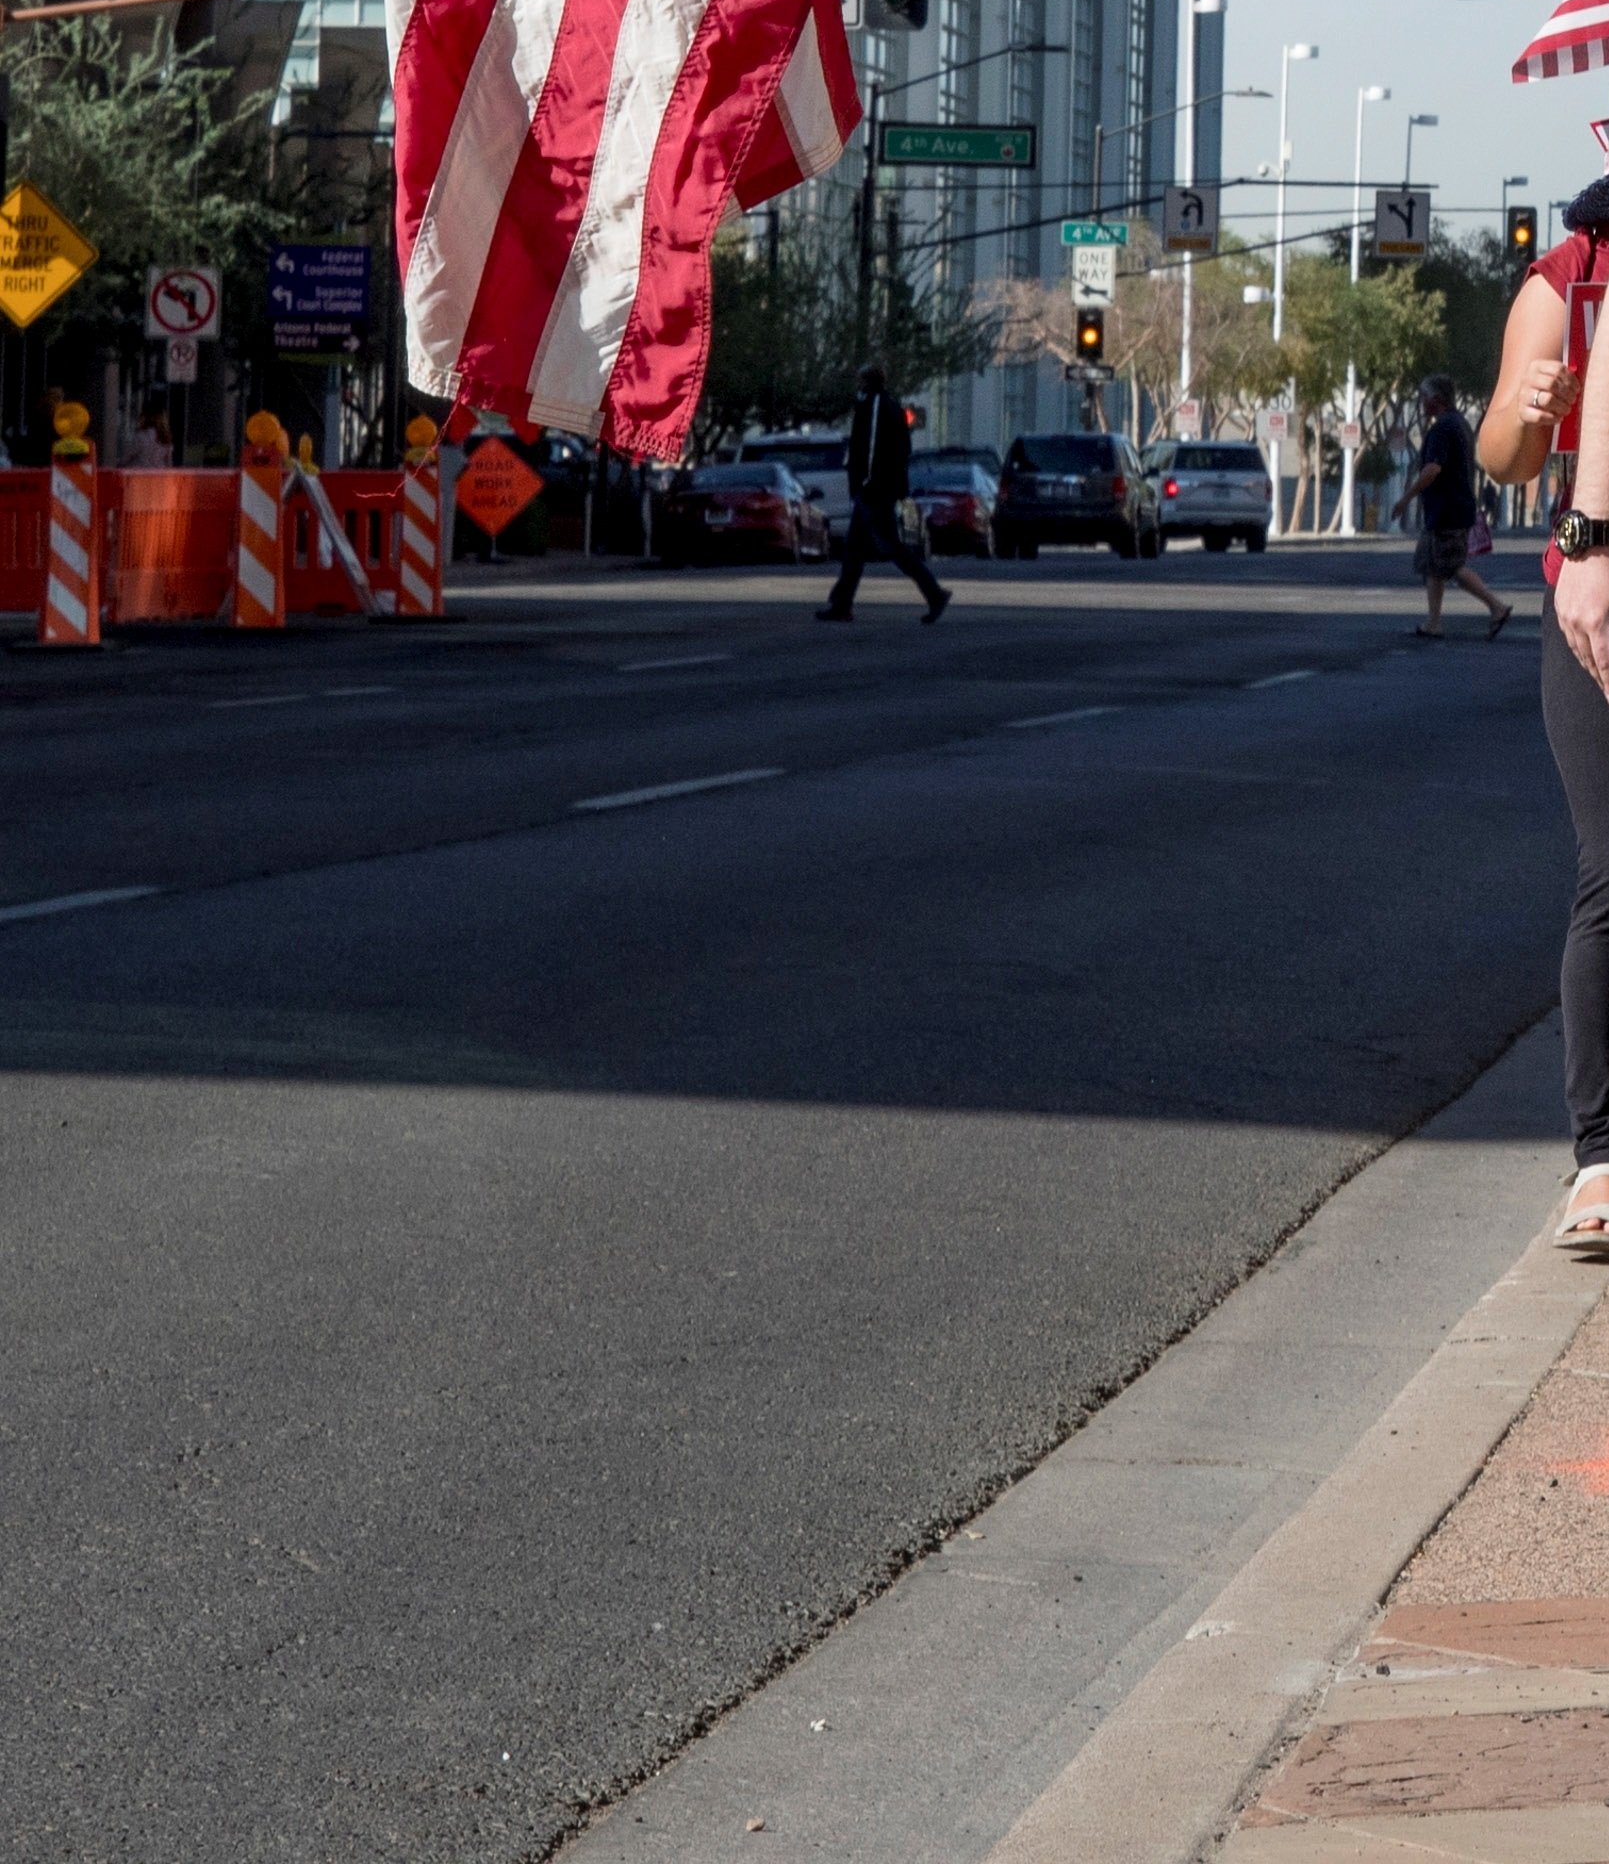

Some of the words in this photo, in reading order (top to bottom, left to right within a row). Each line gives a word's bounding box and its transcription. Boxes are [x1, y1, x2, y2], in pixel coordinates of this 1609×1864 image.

[901, 136, 928, 153] 4th
[0, 235, 61, 253] RAFFIC
[1079, 251, 1109, 266] ONE
[1078, 268, 1109, 282] WAY
[4, 275, 46, 293] RIGHT
